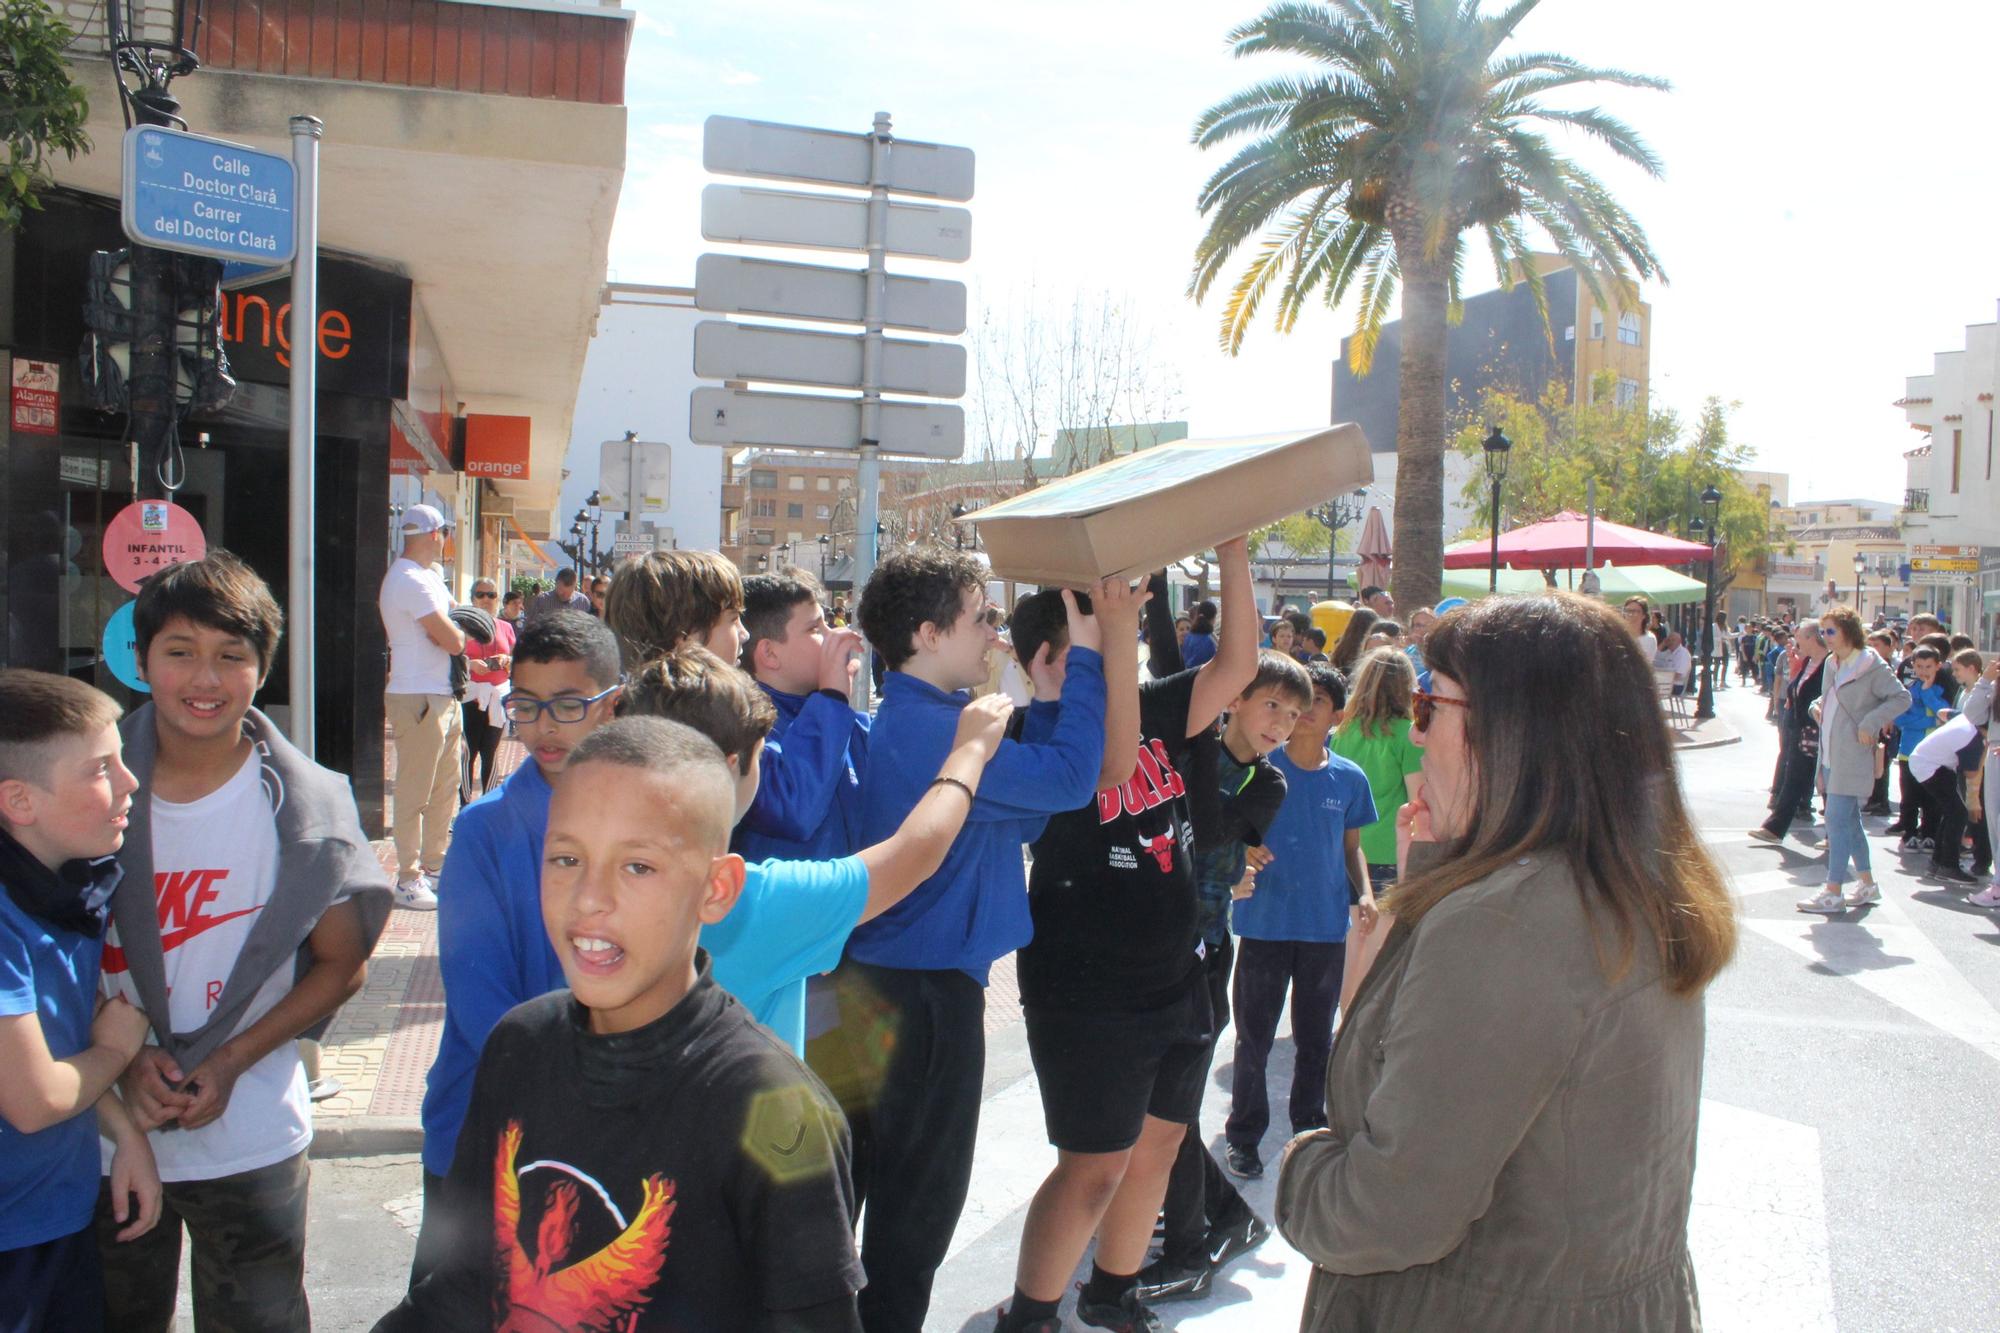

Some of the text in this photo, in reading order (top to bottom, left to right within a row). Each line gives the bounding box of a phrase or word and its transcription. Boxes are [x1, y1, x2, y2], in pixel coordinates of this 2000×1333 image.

[212, 155, 251, 177] Calle
[183, 172, 277, 204] Doctor Clará
[194, 201, 242, 224] Carrer
[155, 216, 277, 251] del Doctor Clará
[467, 460, 523, 476] orange
[127, 543, 186, 554] INFANTIL
[134, 557, 141, 565] 3
[152, 556, 160, 565] 4
[153, 869, 231, 929] IKE
